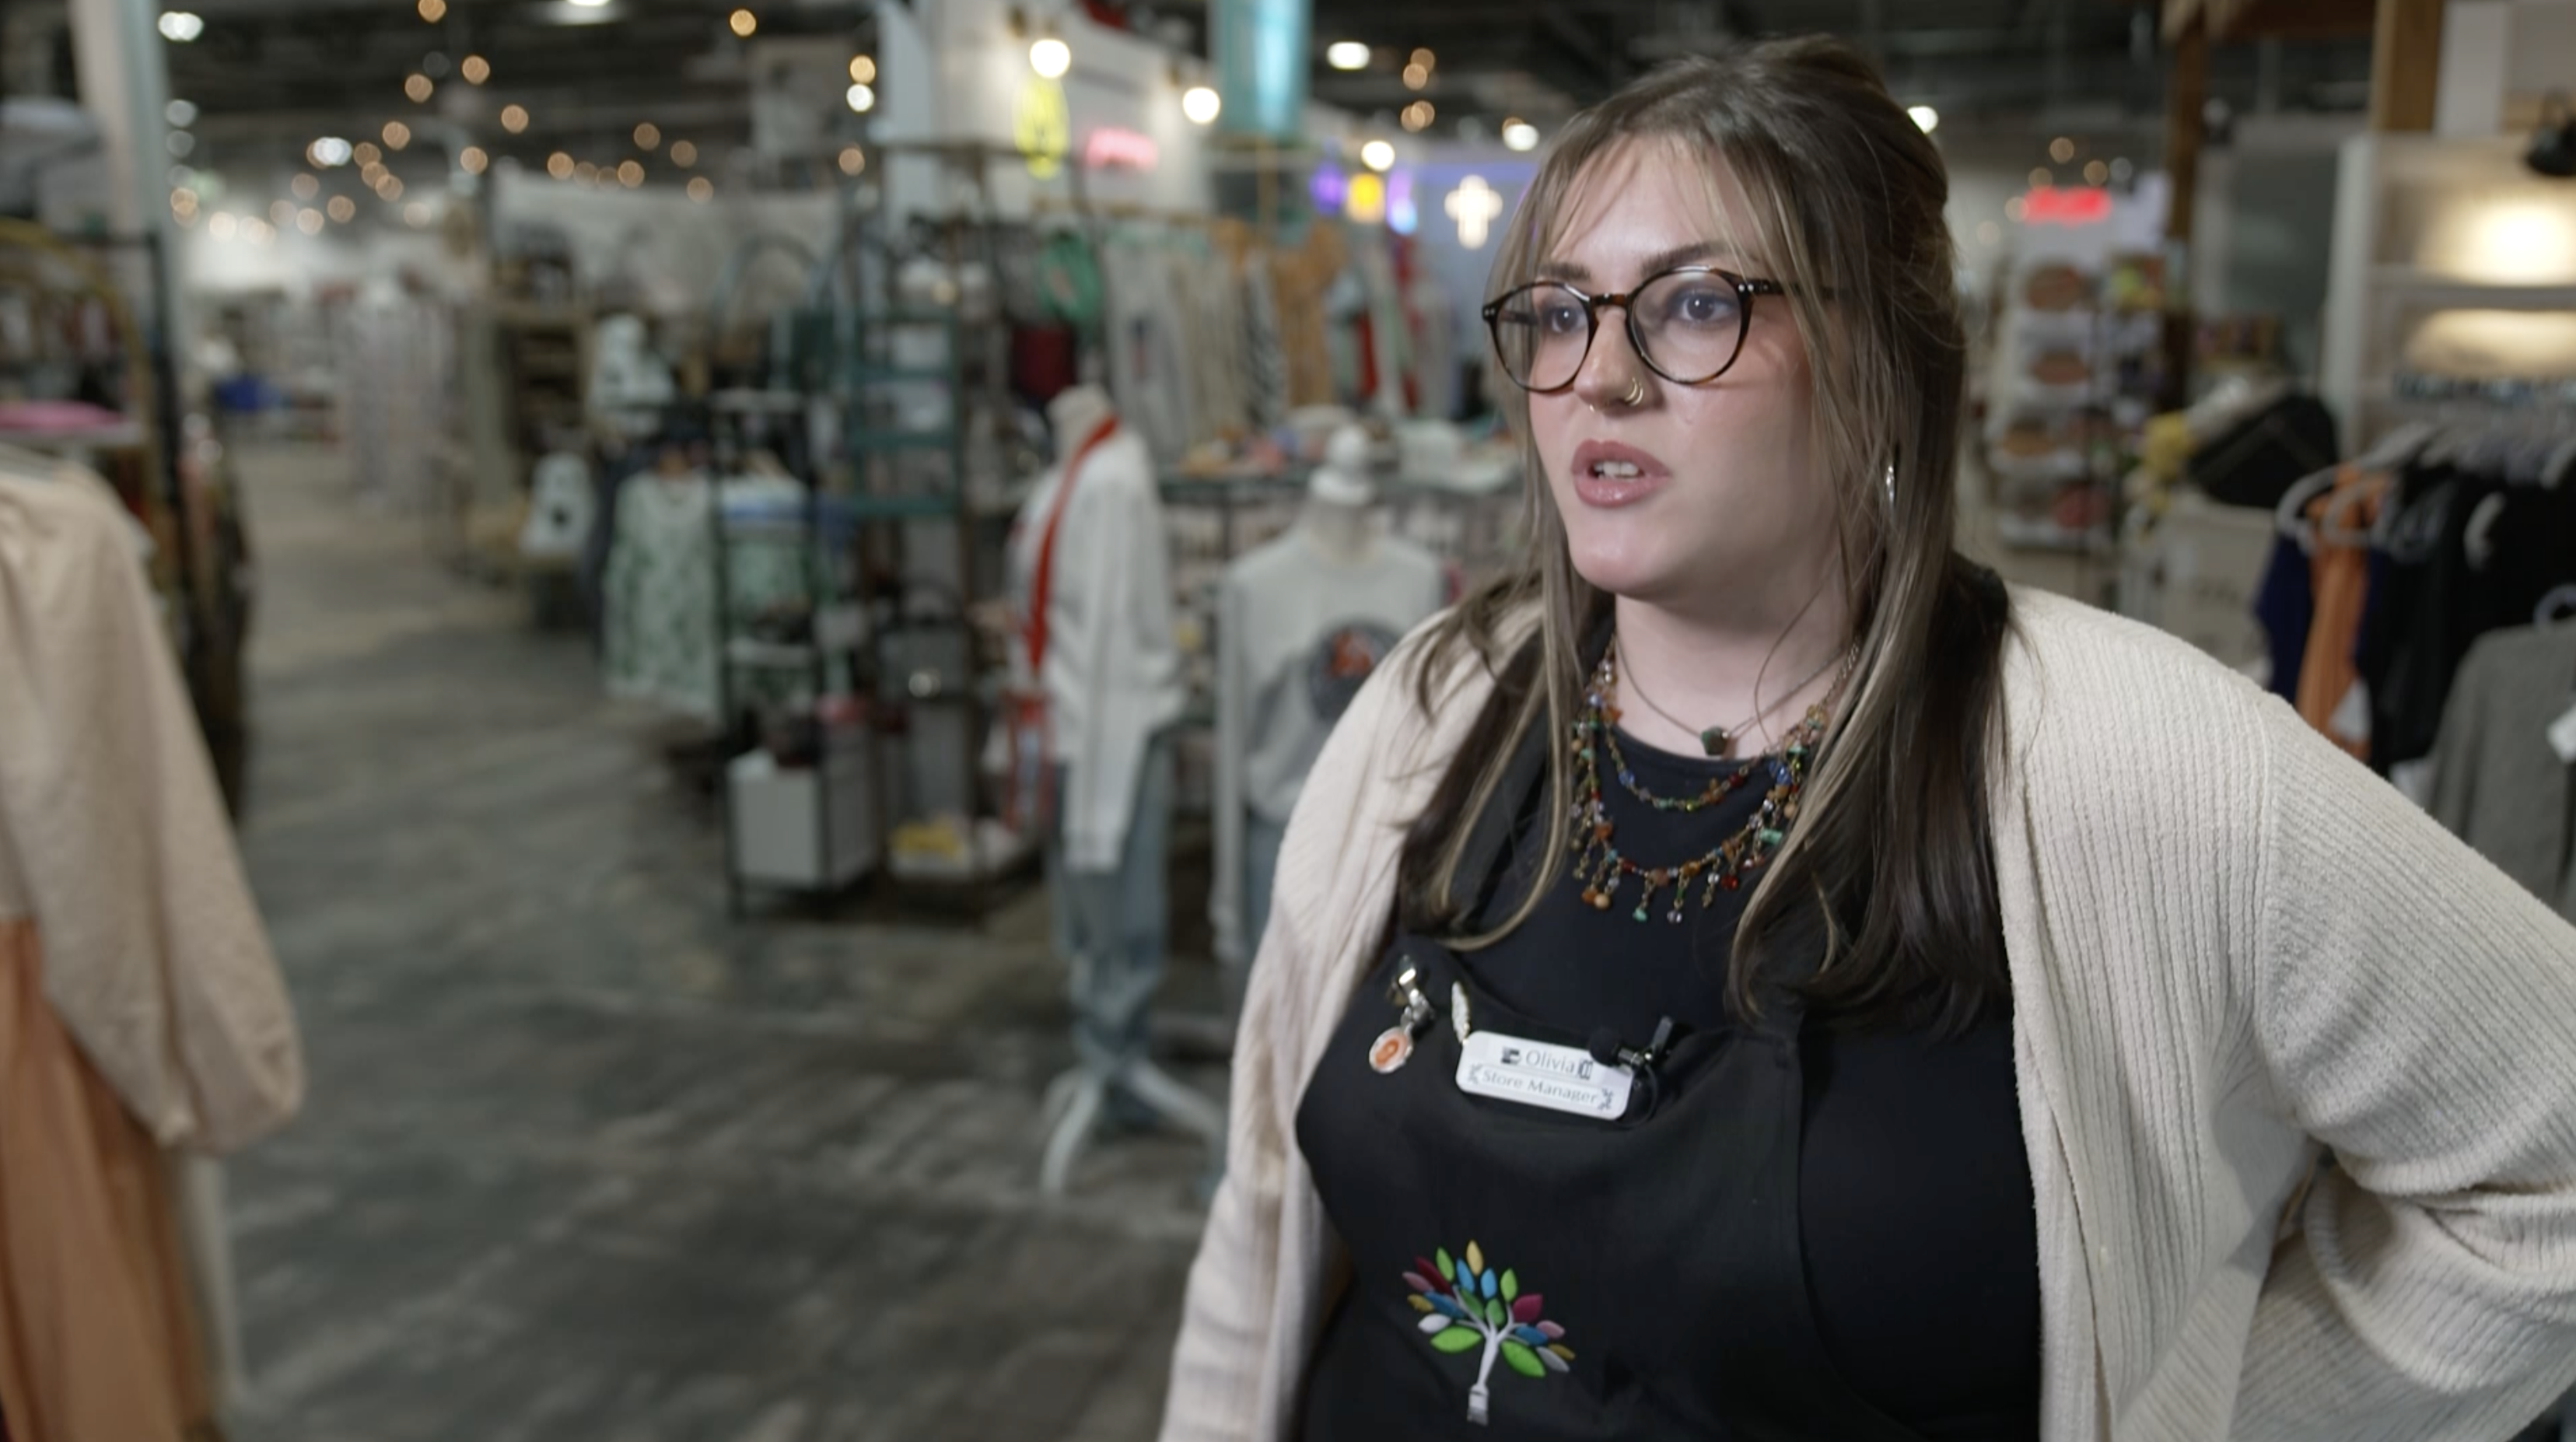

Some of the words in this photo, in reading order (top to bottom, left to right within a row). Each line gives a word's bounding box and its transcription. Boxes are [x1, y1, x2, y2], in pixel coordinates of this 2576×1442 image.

[1525, 1049, 1576, 1074] Olivia
[1482, 1068, 1523, 1087] Store
[1528, 1080, 1598, 1105] Manager
